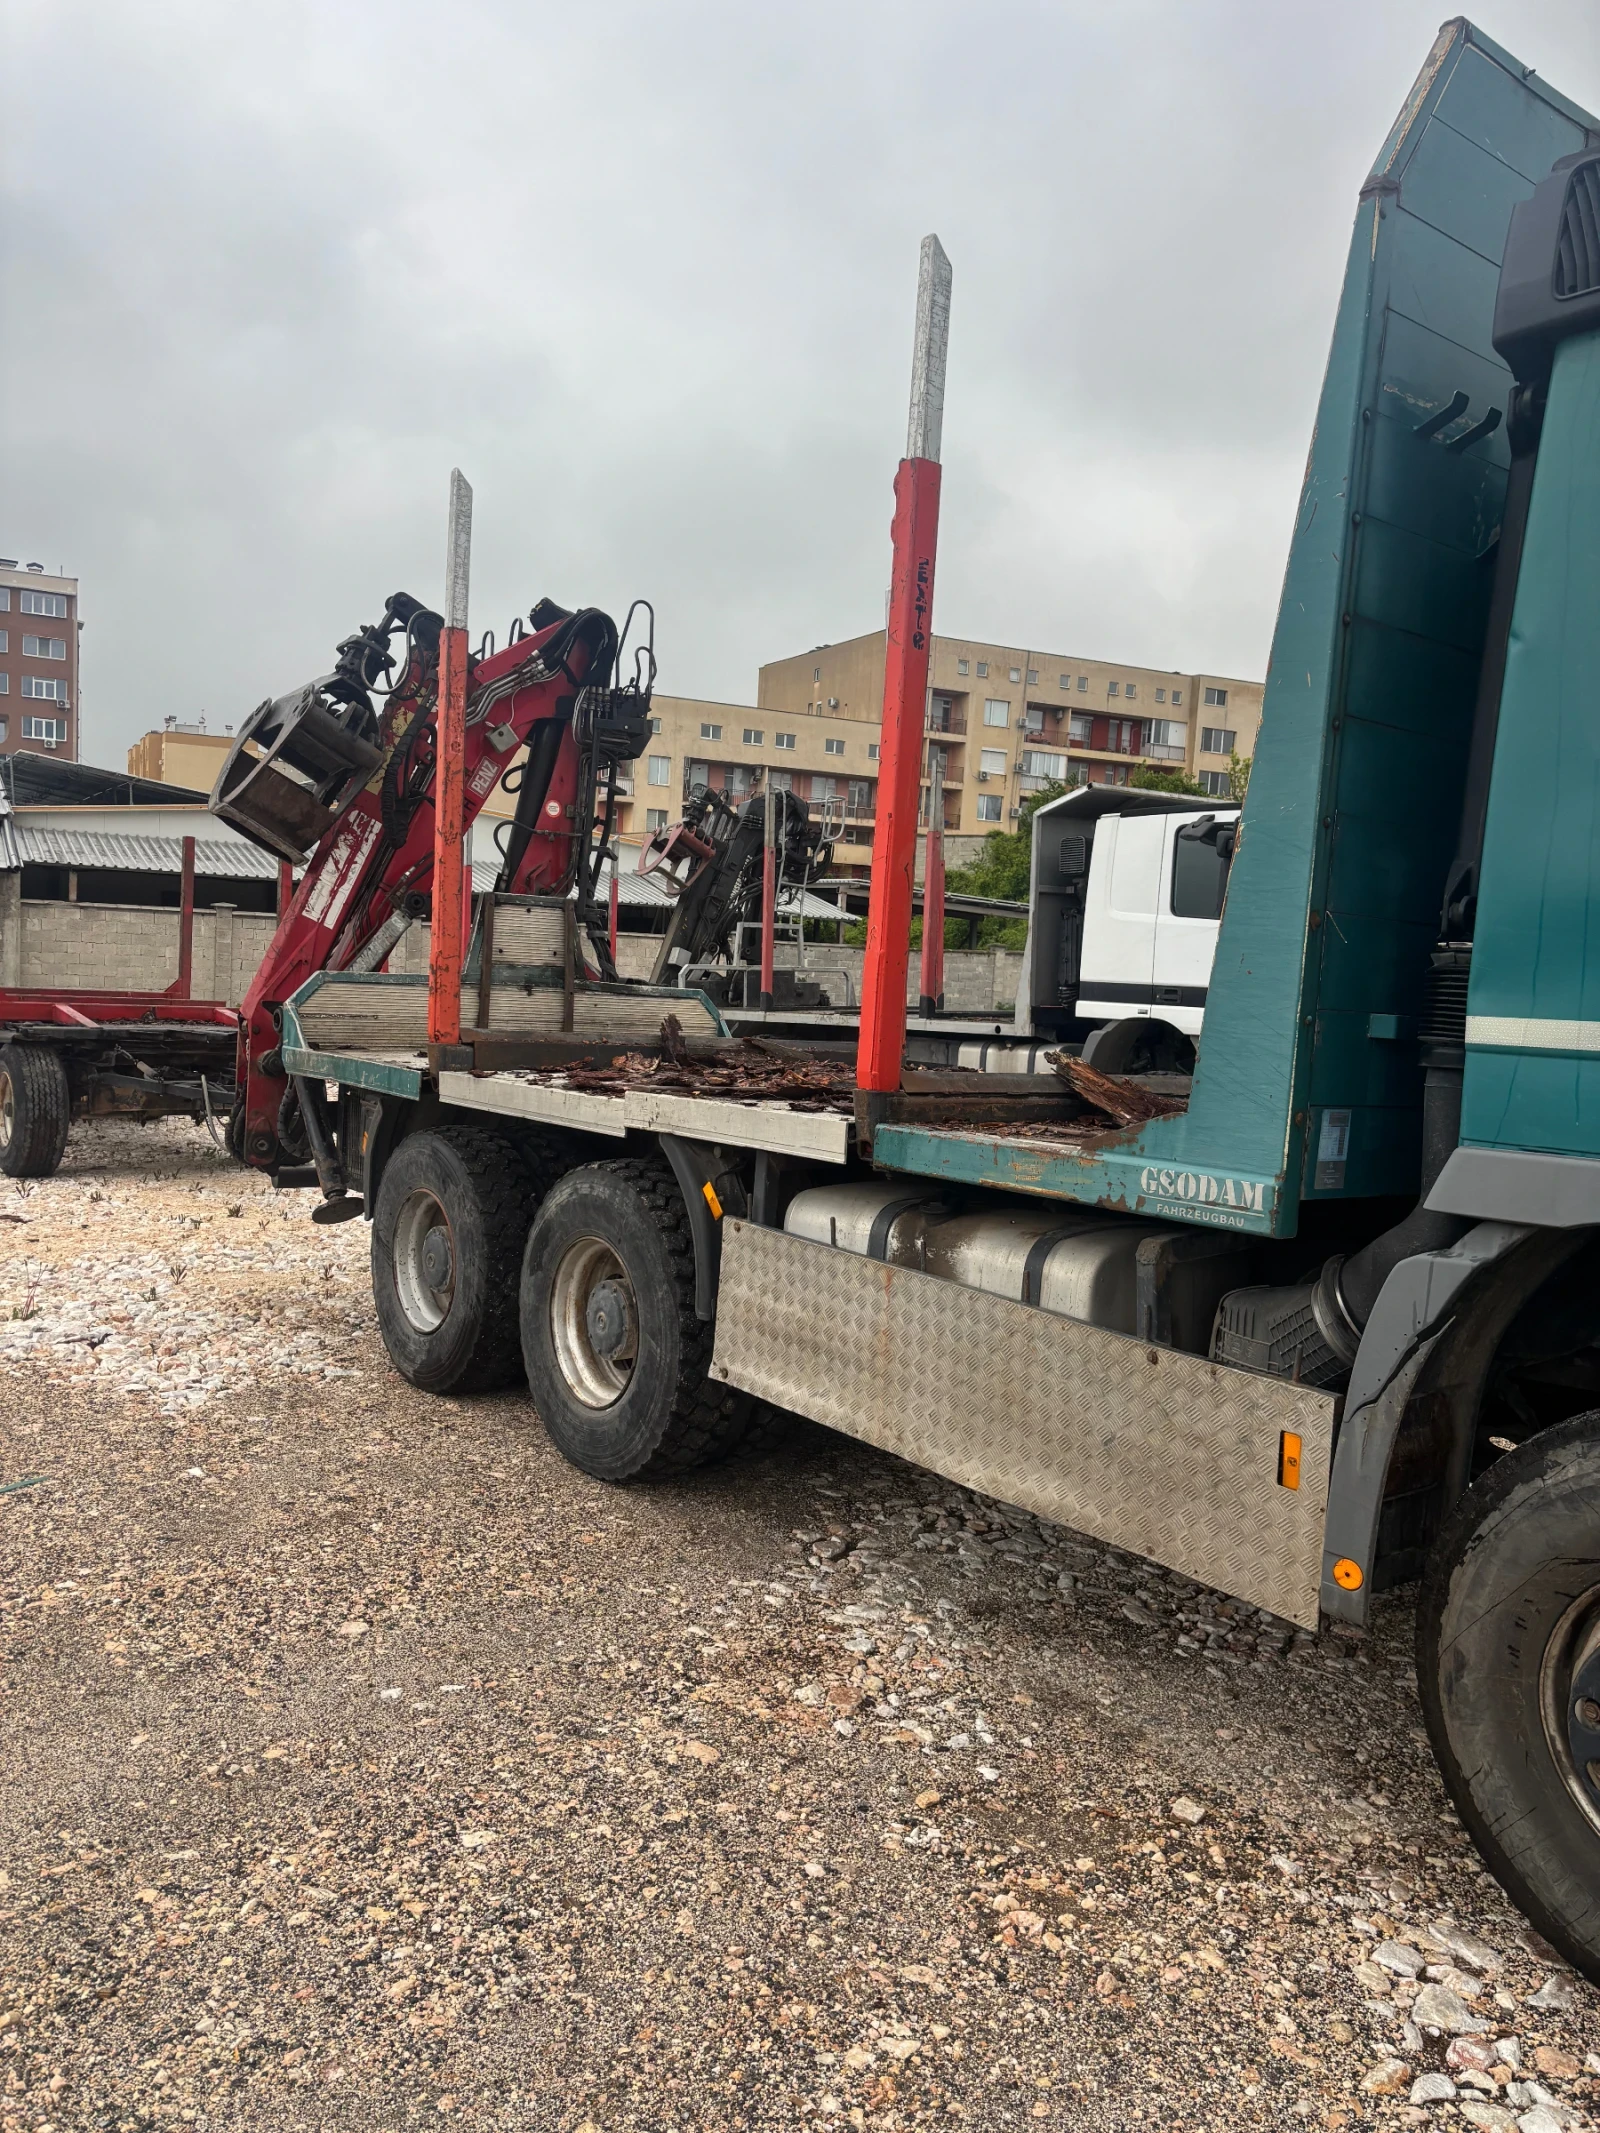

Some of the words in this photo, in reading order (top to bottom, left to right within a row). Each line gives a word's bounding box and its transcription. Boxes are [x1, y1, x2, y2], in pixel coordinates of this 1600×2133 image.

[471, 760, 499, 795] PENZ
[1140, 1166, 1264, 1211] GSODAM
[1156, 1203, 1245, 1228] FAHRZEUGBAU
